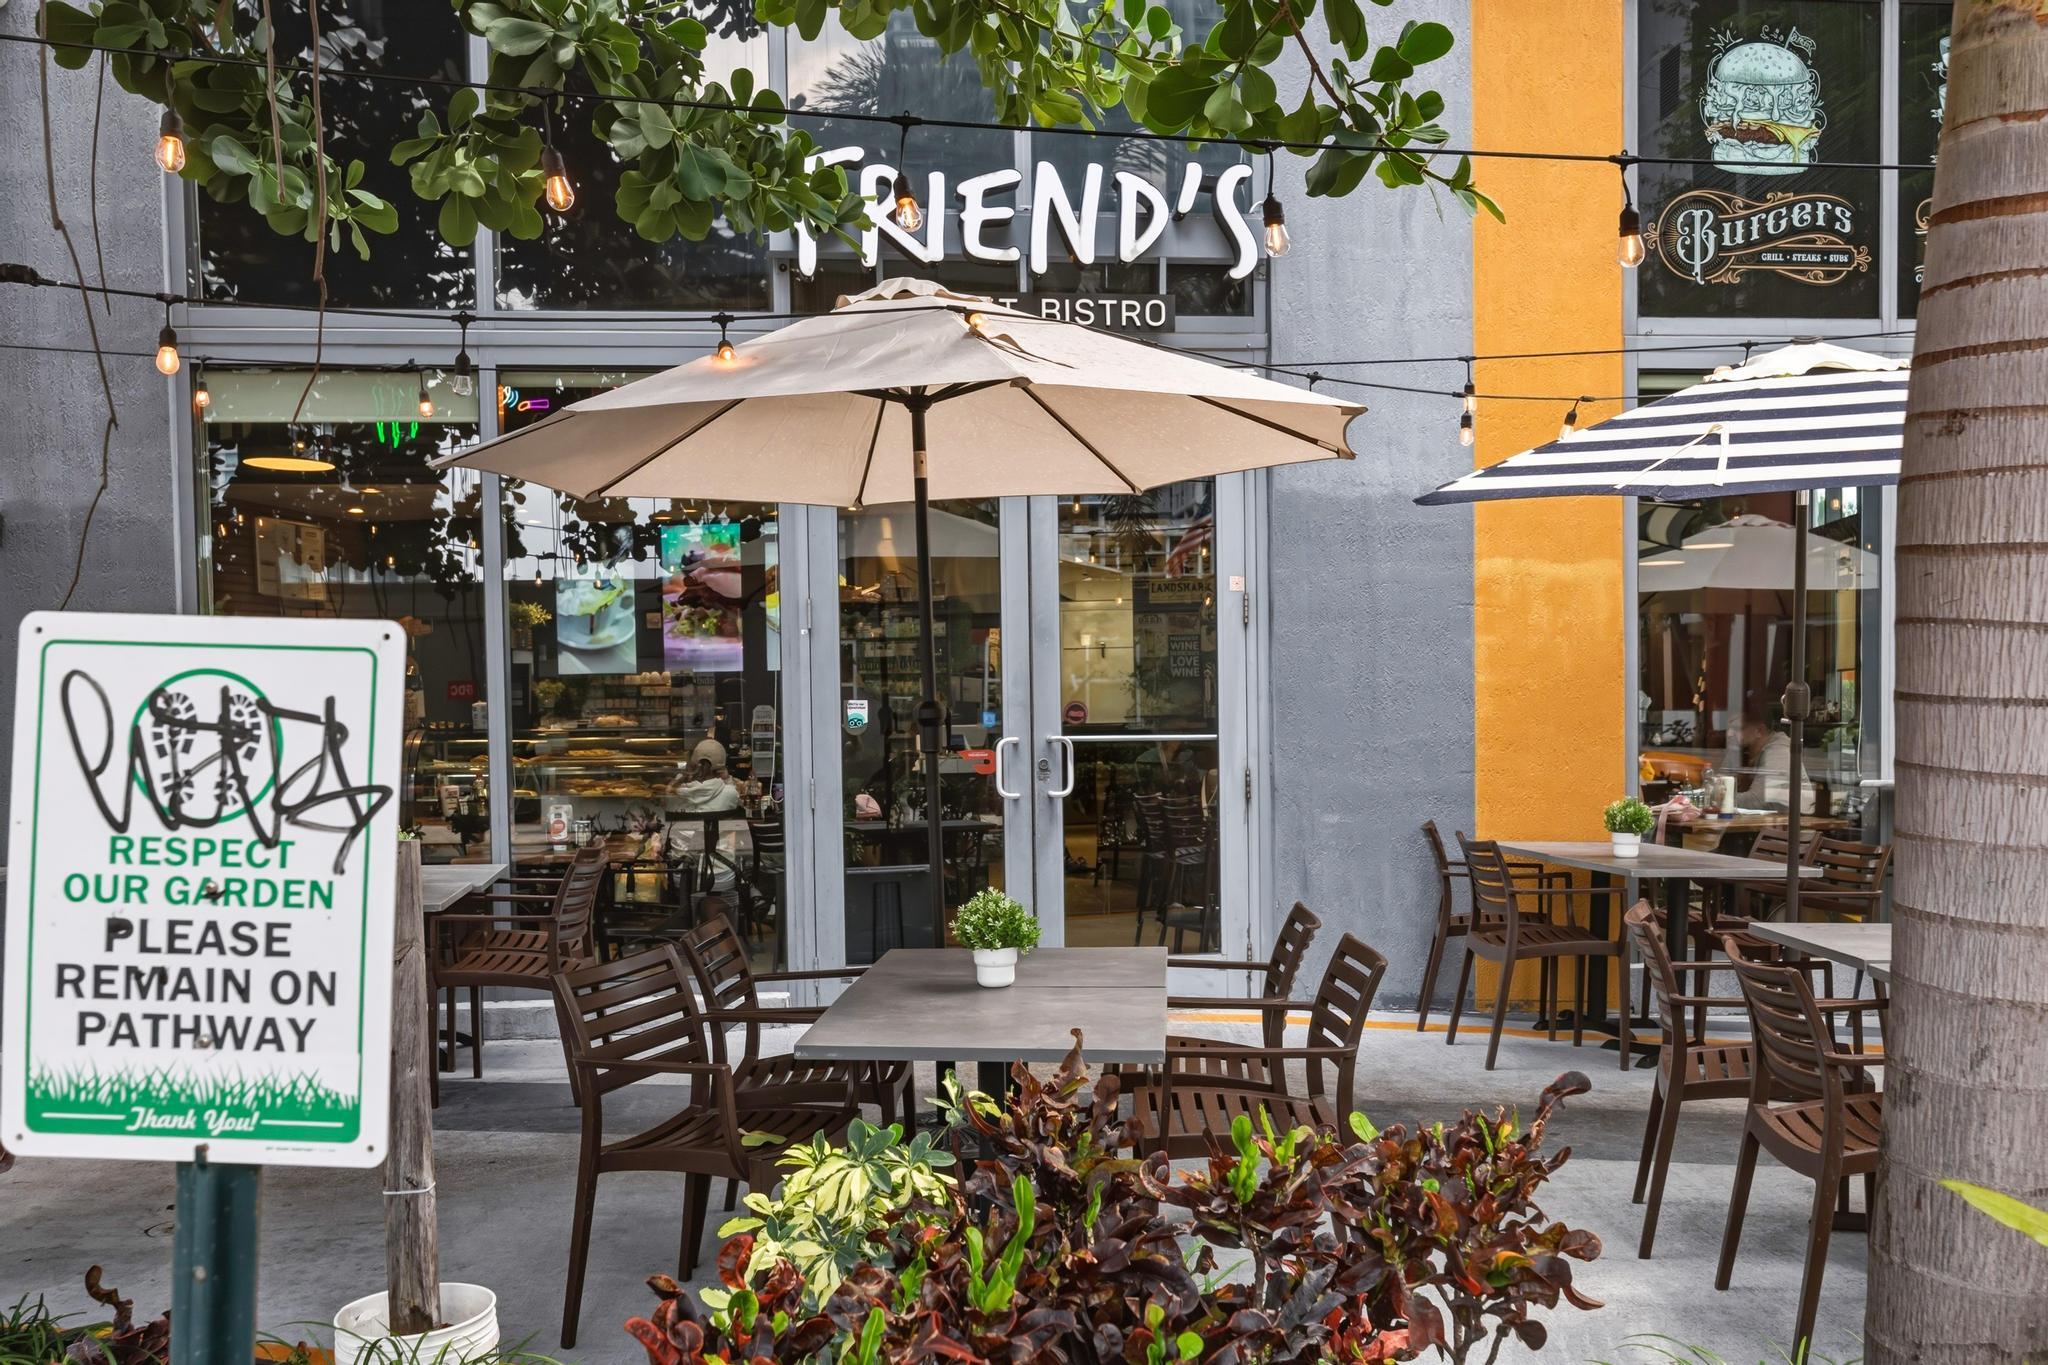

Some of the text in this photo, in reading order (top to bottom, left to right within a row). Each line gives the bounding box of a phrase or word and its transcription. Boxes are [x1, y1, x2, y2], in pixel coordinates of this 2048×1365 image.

[794, 146, 1259, 280] FRIEND'S
[1761, 253, 1849, 262] GRILL STEAKS SUBS
[1041, 298, 1166, 326] BISTRO
[1170, 641, 1199, 650] WINE
[1170, 656, 1199, 667] LOVE
[1171, 667, 1200, 677] WINE
[109, 835, 295, 869] RESPECT
[63, 873, 335, 910] OUR GARDEN
[104, 917, 292, 957] PLEASE
[55, 963, 338, 1006] REMAIN ON
[77, 1012, 317, 1053] PATHWAY
[126, 1106, 261, 1135] Thank You!
